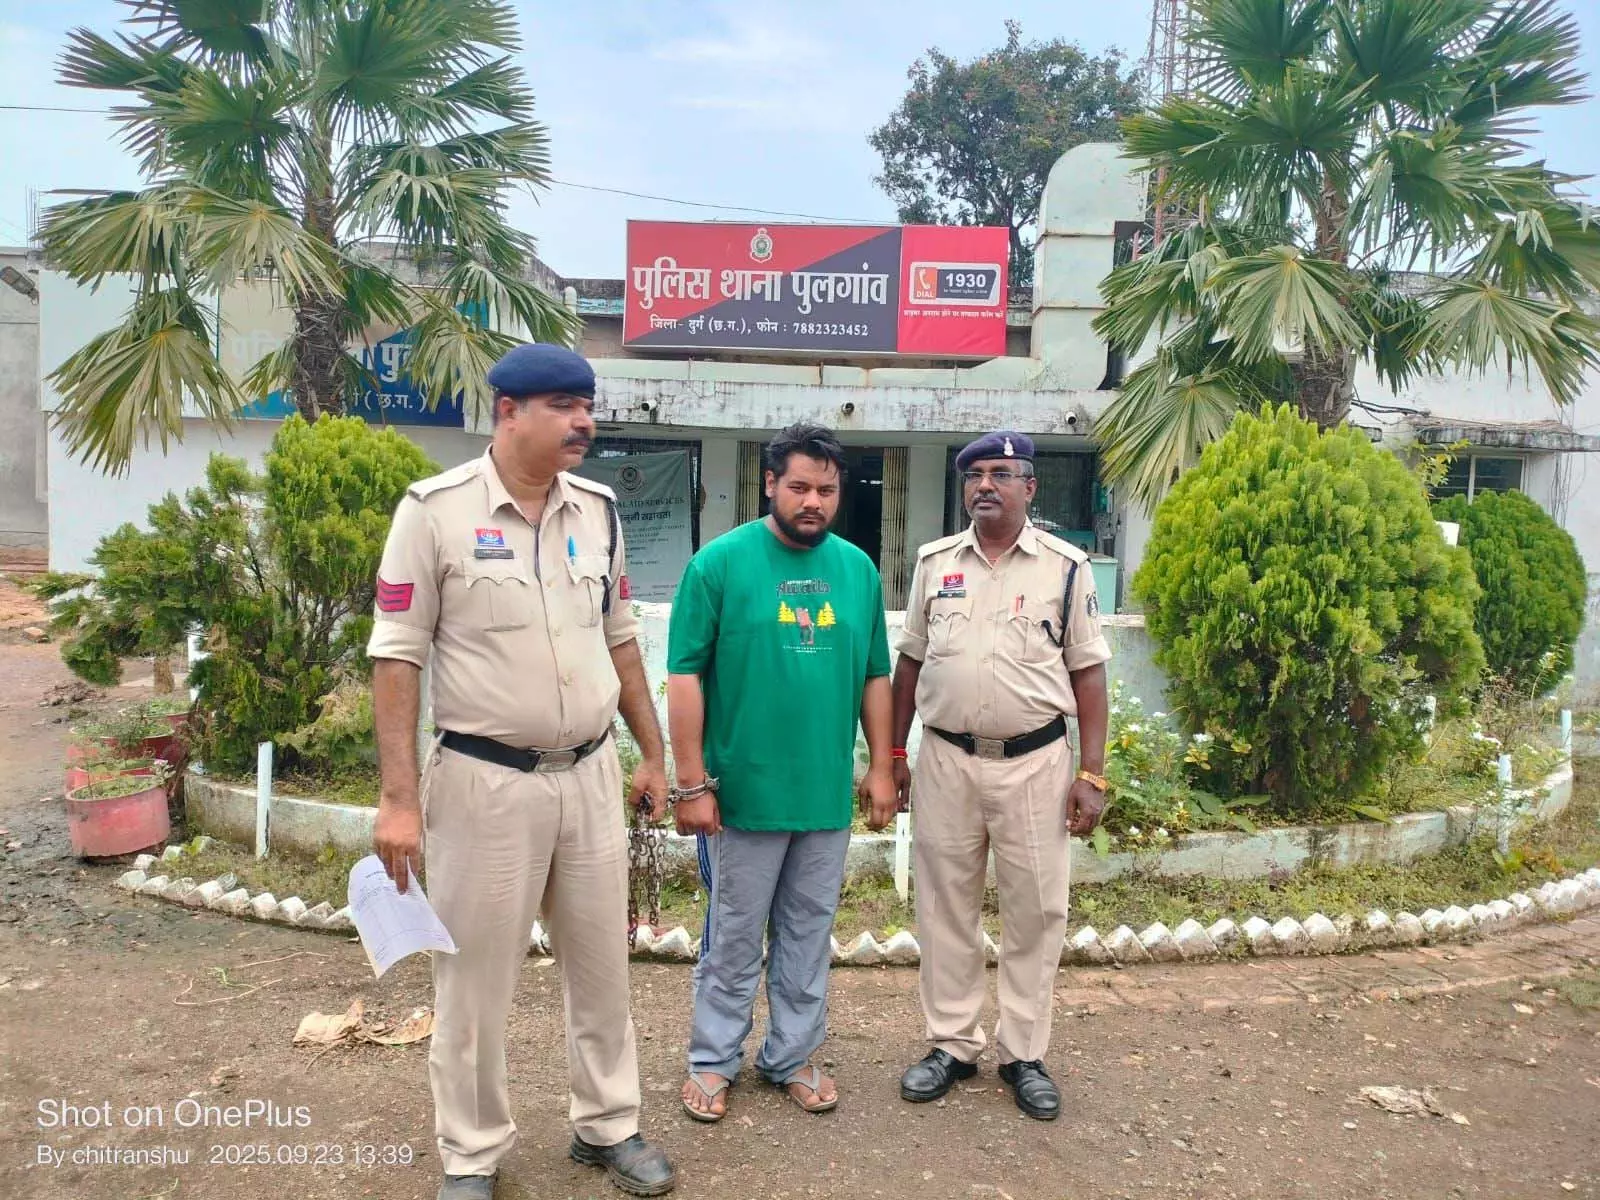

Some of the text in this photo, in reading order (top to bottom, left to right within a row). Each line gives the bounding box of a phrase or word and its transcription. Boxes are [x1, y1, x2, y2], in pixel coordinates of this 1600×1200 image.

[631, 256, 889, 314] पुलिस थाना पुलगांव
[945, 273, 987, 288] 1930
[688, 315, 704, 334] दुर्ग
[756, 319, 778, 333] फोन
[792, 321, 869, 336] 7882323452
